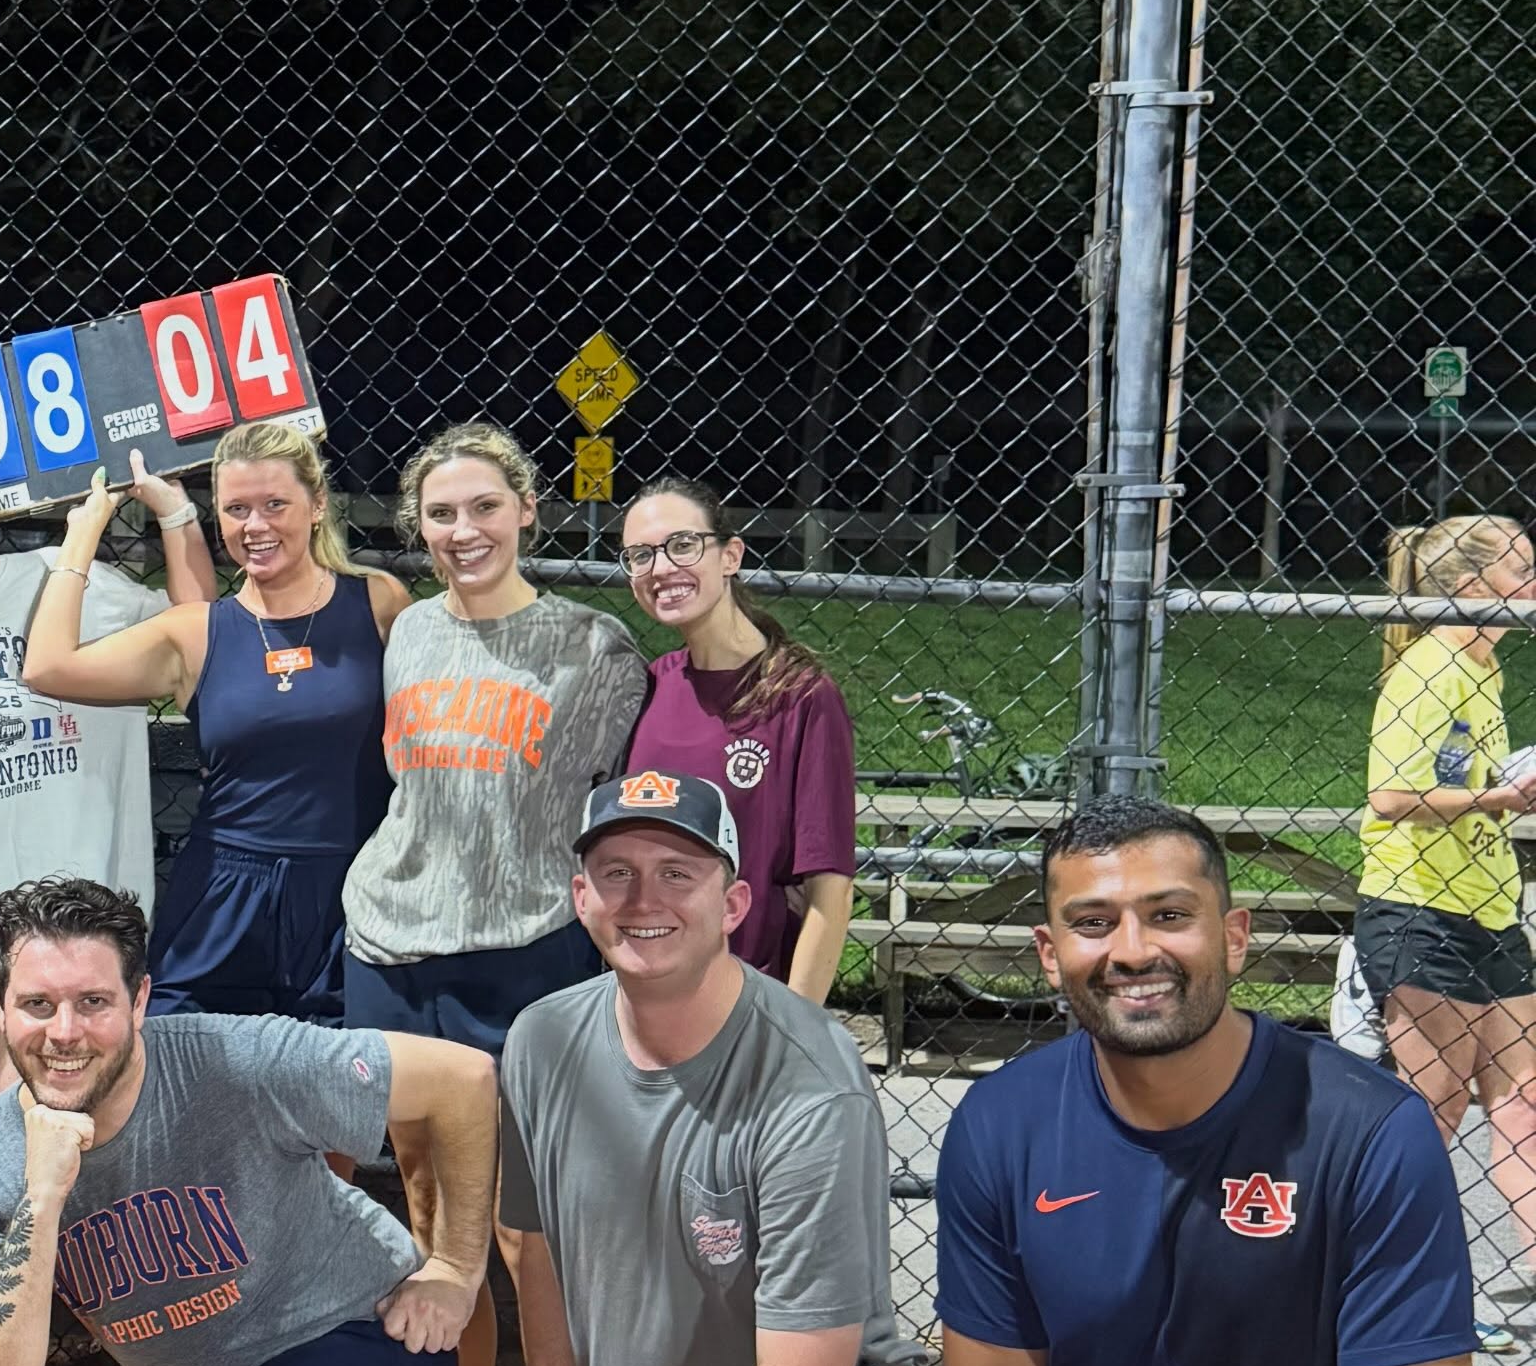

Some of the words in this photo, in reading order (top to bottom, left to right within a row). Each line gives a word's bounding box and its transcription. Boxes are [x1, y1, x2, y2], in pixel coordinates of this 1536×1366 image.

[575, 367, 618, 382] SPEED
[103, 403, 159, 429] PERIOD
[108, 417, 161, 442] GAMES
[1, 722, 25, 736] FOUR
[393, 745, 508, 774] BLOODLINE
[724, 738, 770, 766] HARVARD
[101, 1310, 164, 1345] APHIC
[164, 1279, 243, 1331] DESIGN
